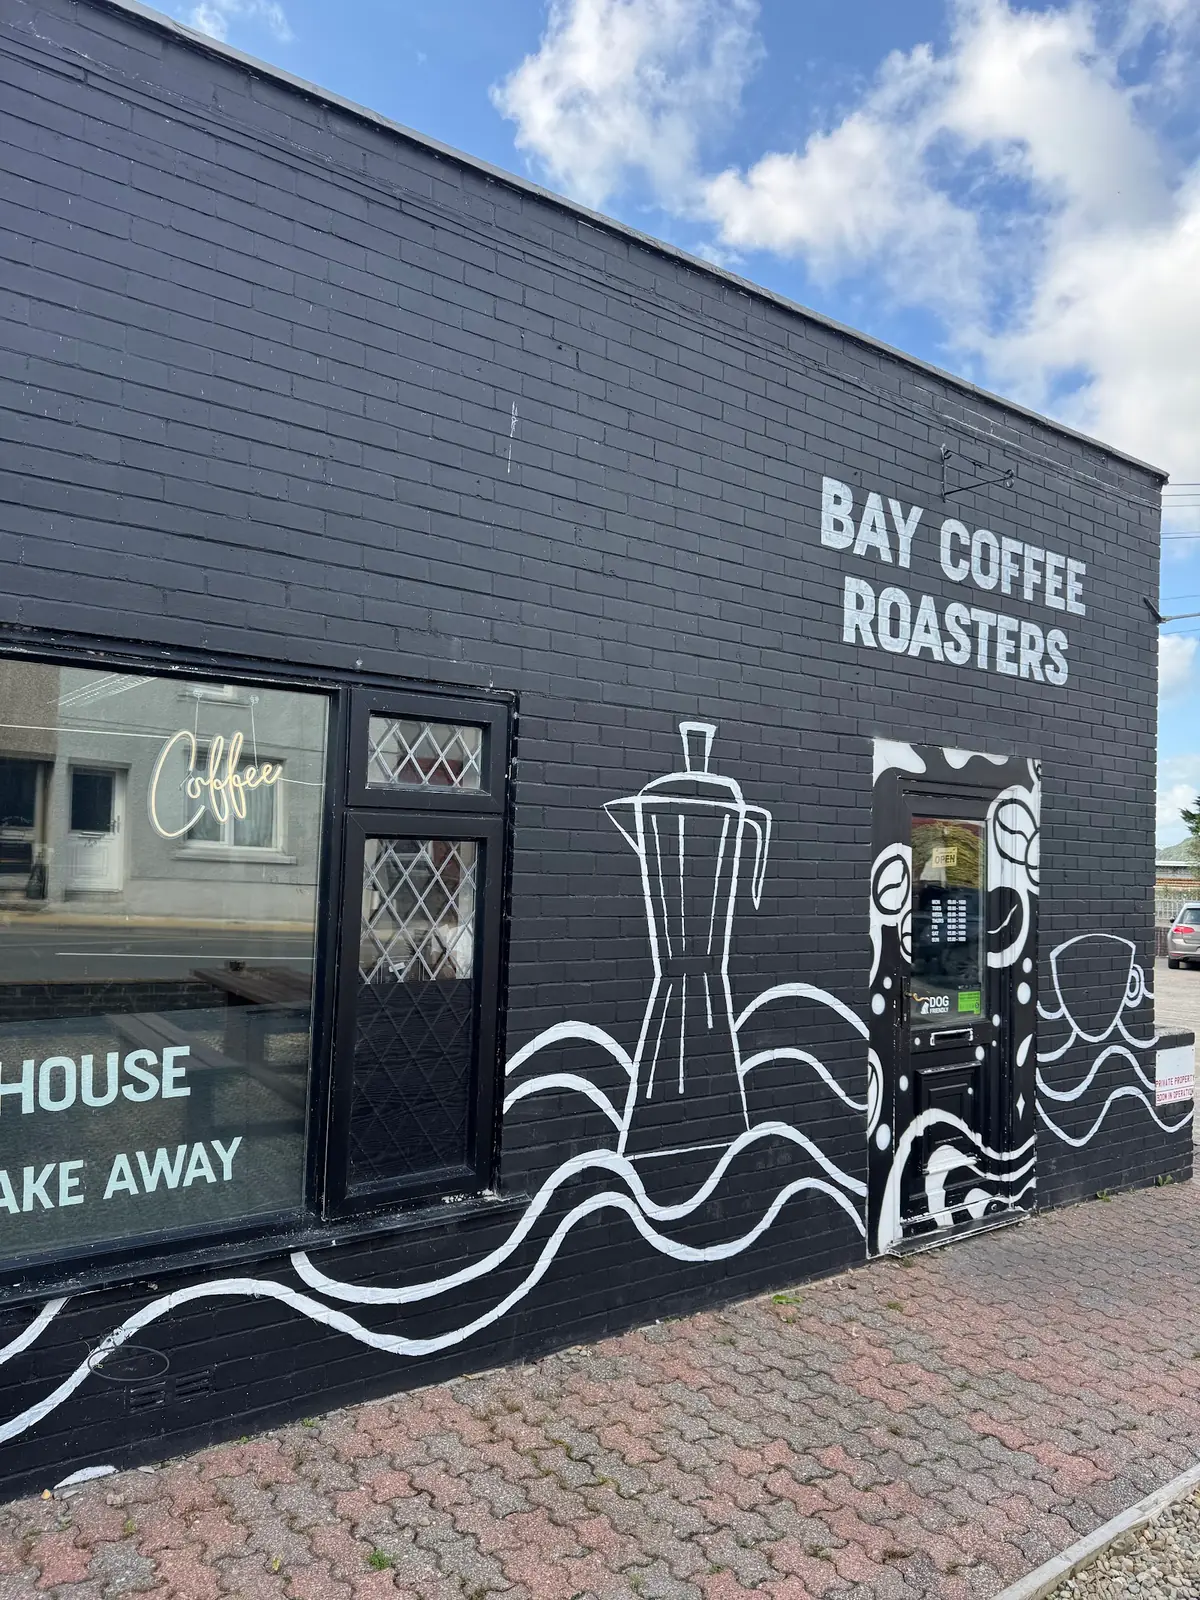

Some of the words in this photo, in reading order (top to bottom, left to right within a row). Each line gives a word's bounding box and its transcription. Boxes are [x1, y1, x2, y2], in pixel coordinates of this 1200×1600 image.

[821, 476, 923, 568] BAY
[940, 519, 1086, 616] COFFEE
[843, 576, 1069, 686] ROASTERS
[150, 730, 283, 838] Coffee
[935, 854, 956, 864] OPEN
[930, 995, 949, 1007] DOG
[0, 1045, 191, 1115] HOUSE
[103, 1136, 243, 1200] AWAY
